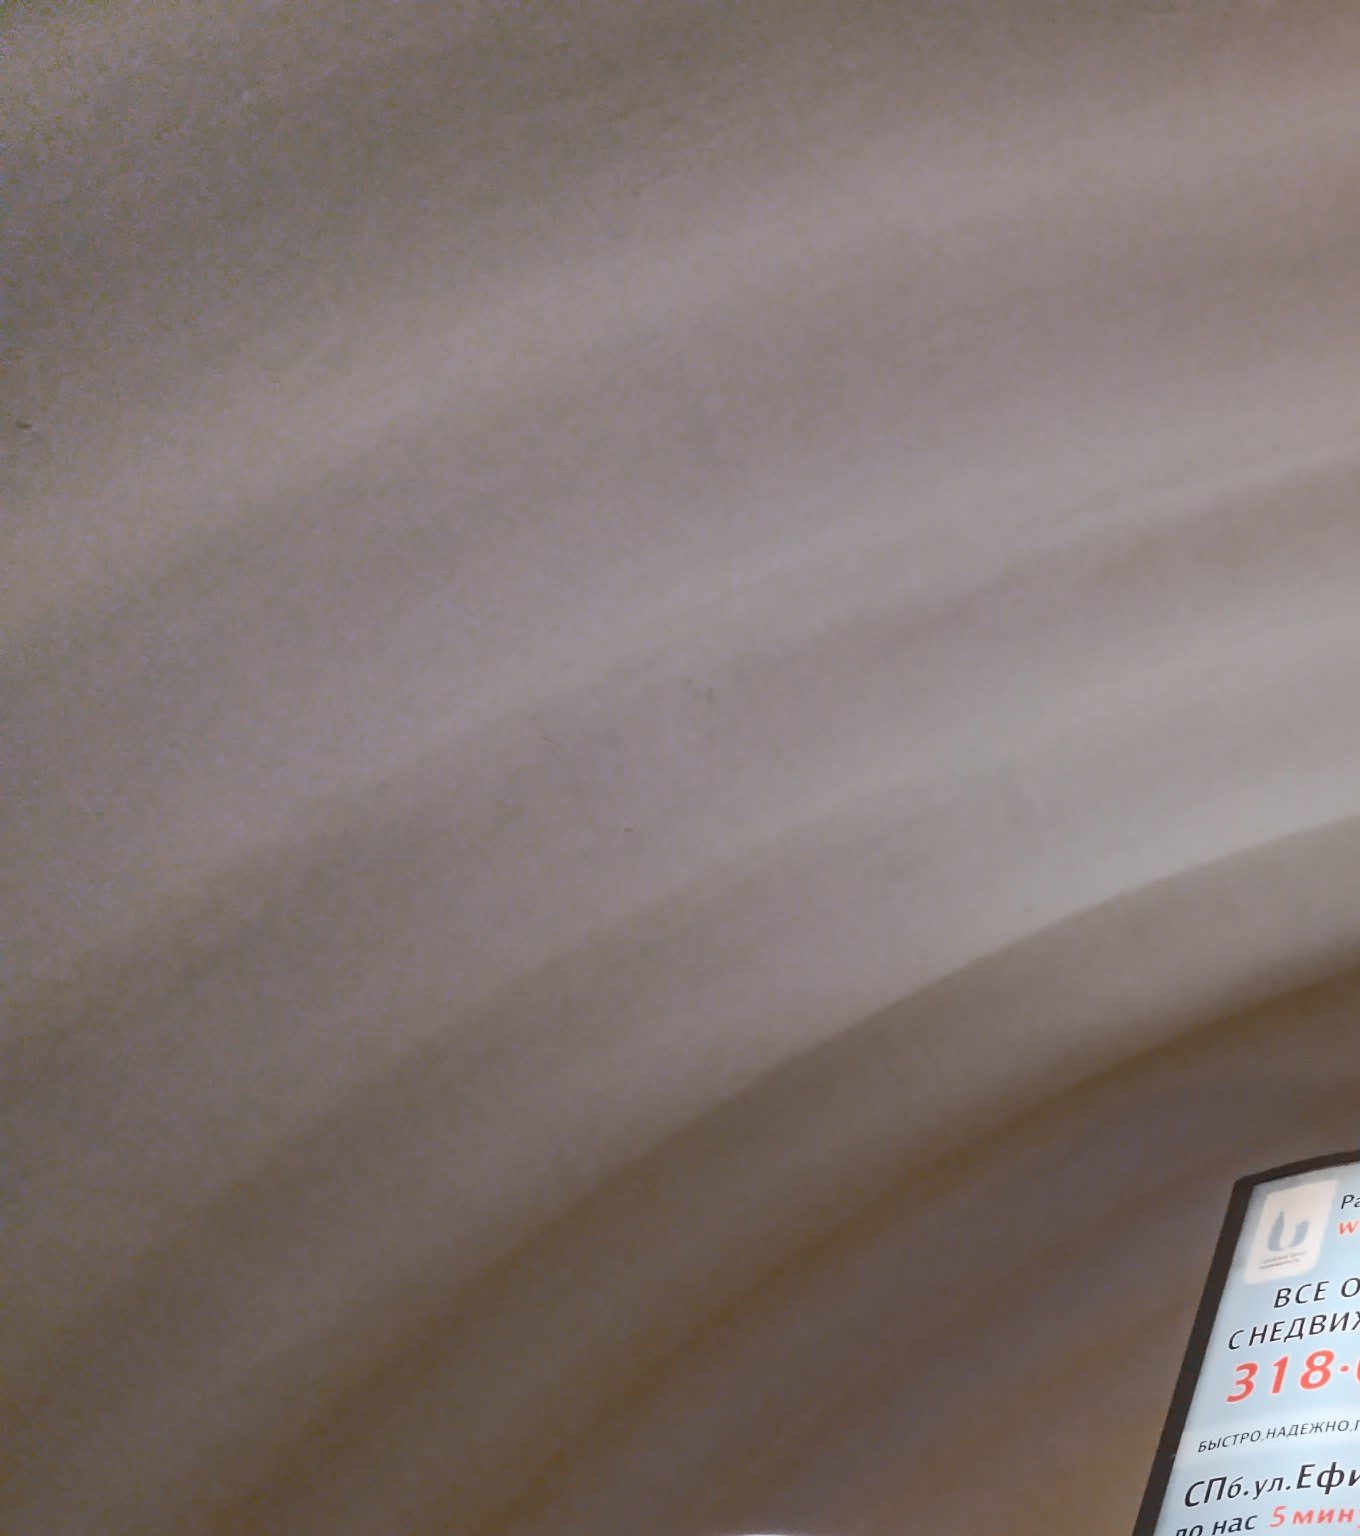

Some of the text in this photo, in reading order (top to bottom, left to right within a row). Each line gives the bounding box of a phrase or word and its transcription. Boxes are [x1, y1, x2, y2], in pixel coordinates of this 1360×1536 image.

[1273, 1281, 1330, 1309] ВСЕ
[1212, 1513, 1258, 1536] нас
[1268, 1505, 1287, 1528] 5
